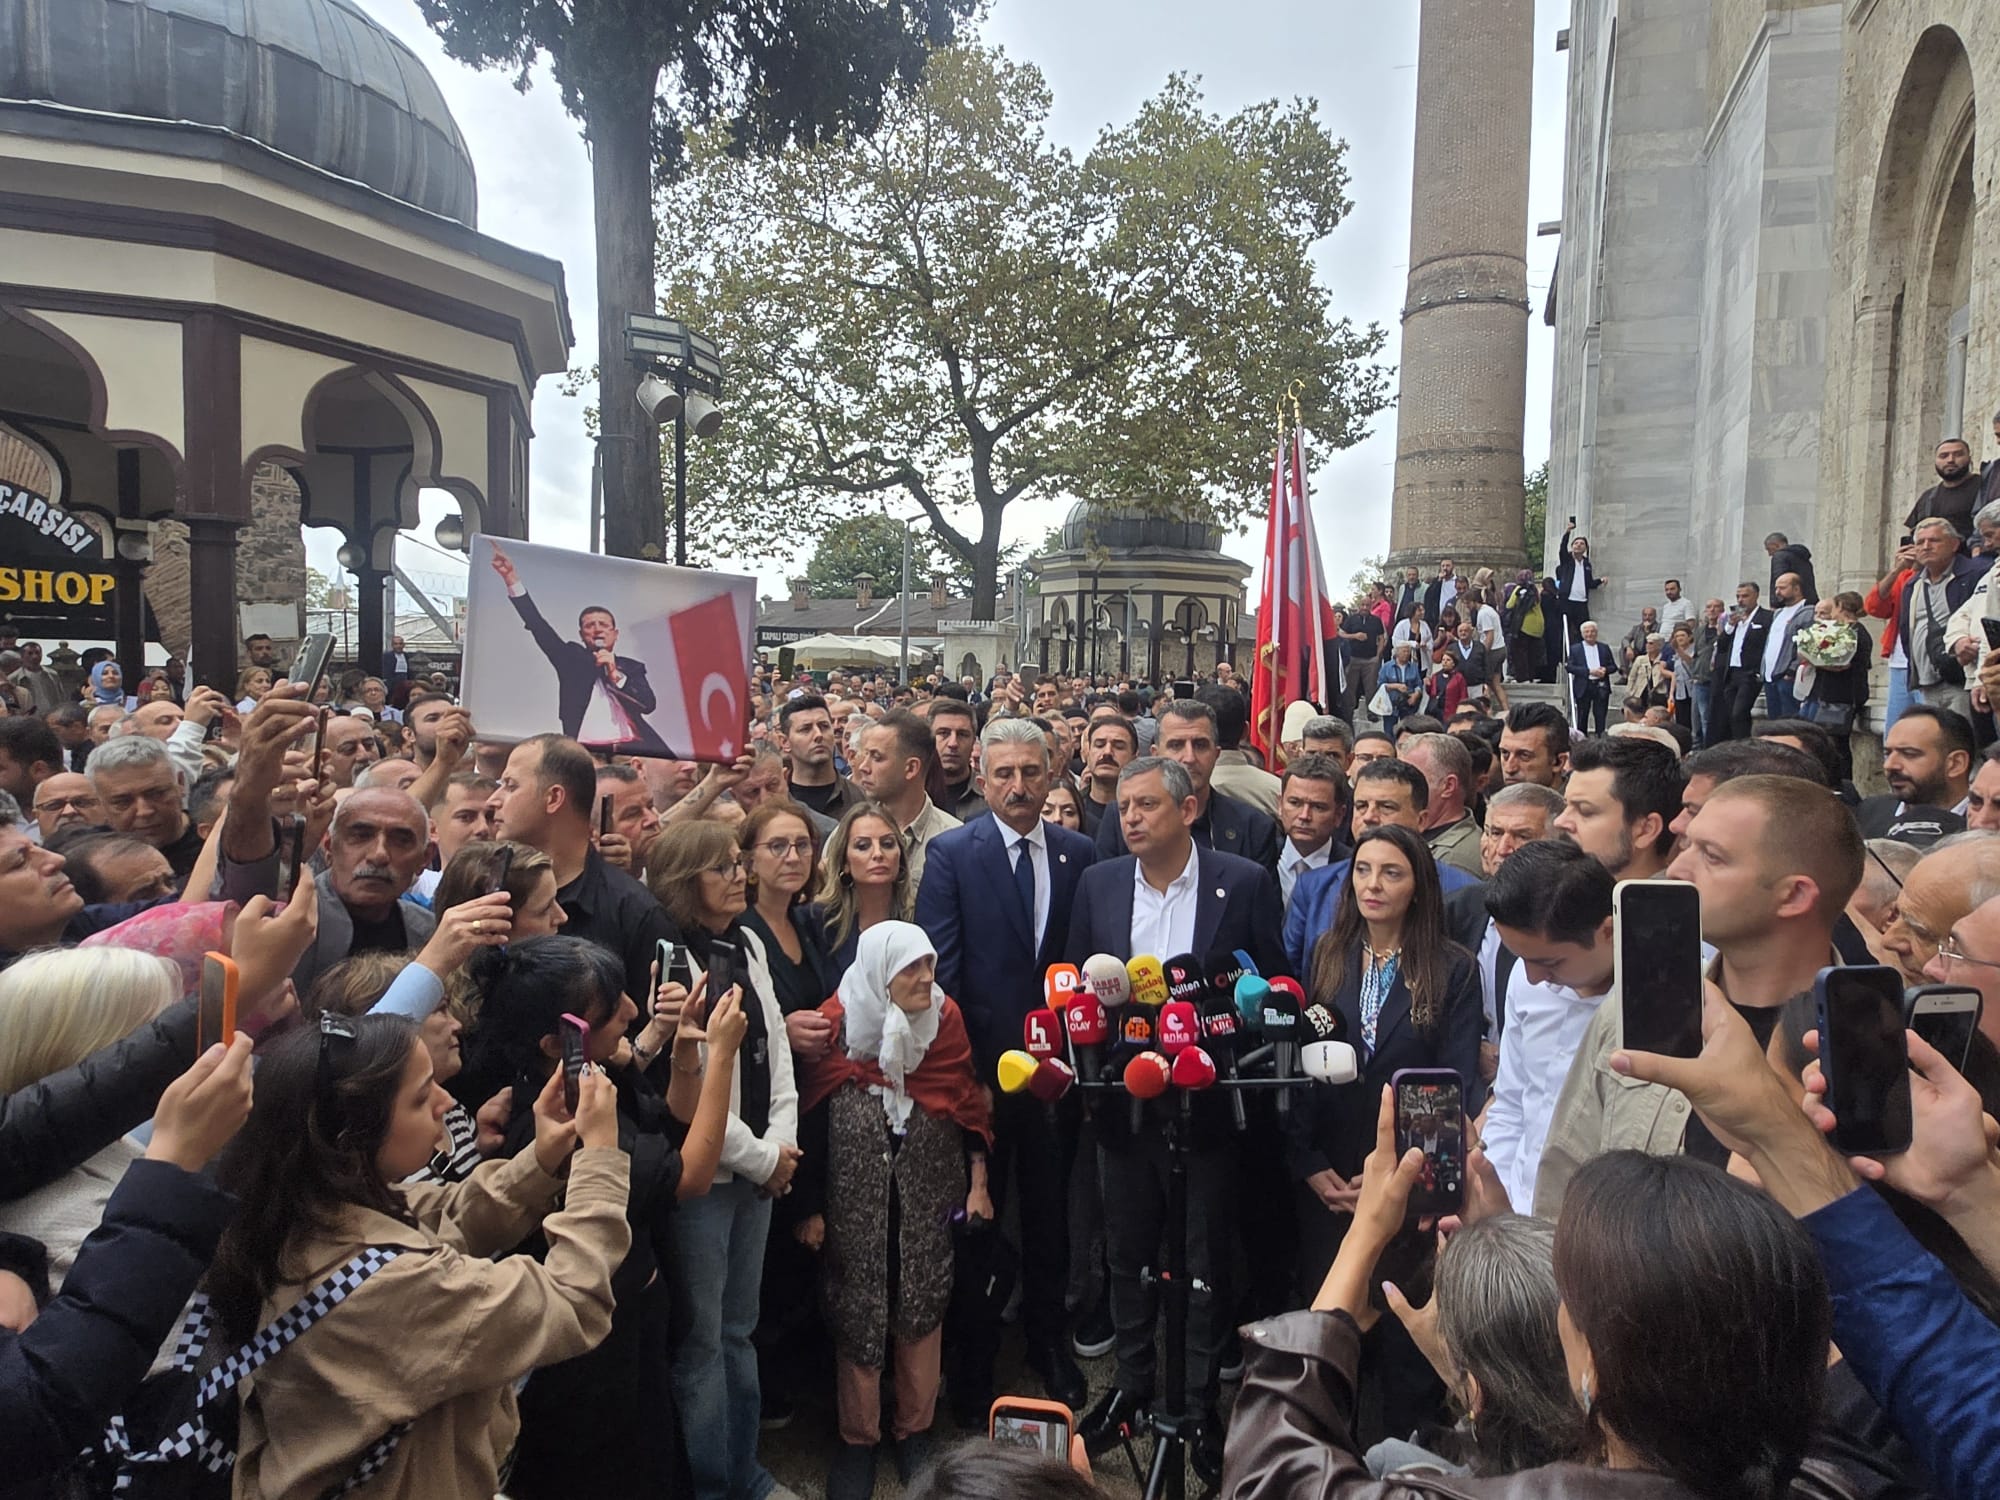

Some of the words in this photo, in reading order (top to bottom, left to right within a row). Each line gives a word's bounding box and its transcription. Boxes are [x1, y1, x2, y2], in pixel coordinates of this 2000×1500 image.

[0, 484, 95, 554] ÇARŞISI
[0, 567, 115, 605] SHOP
[1069, 1021, 1092, 1032] OLAY
[1211, 1018, 1234, 1033] ABC
[1163, 1028, 1191, 1043] anka
